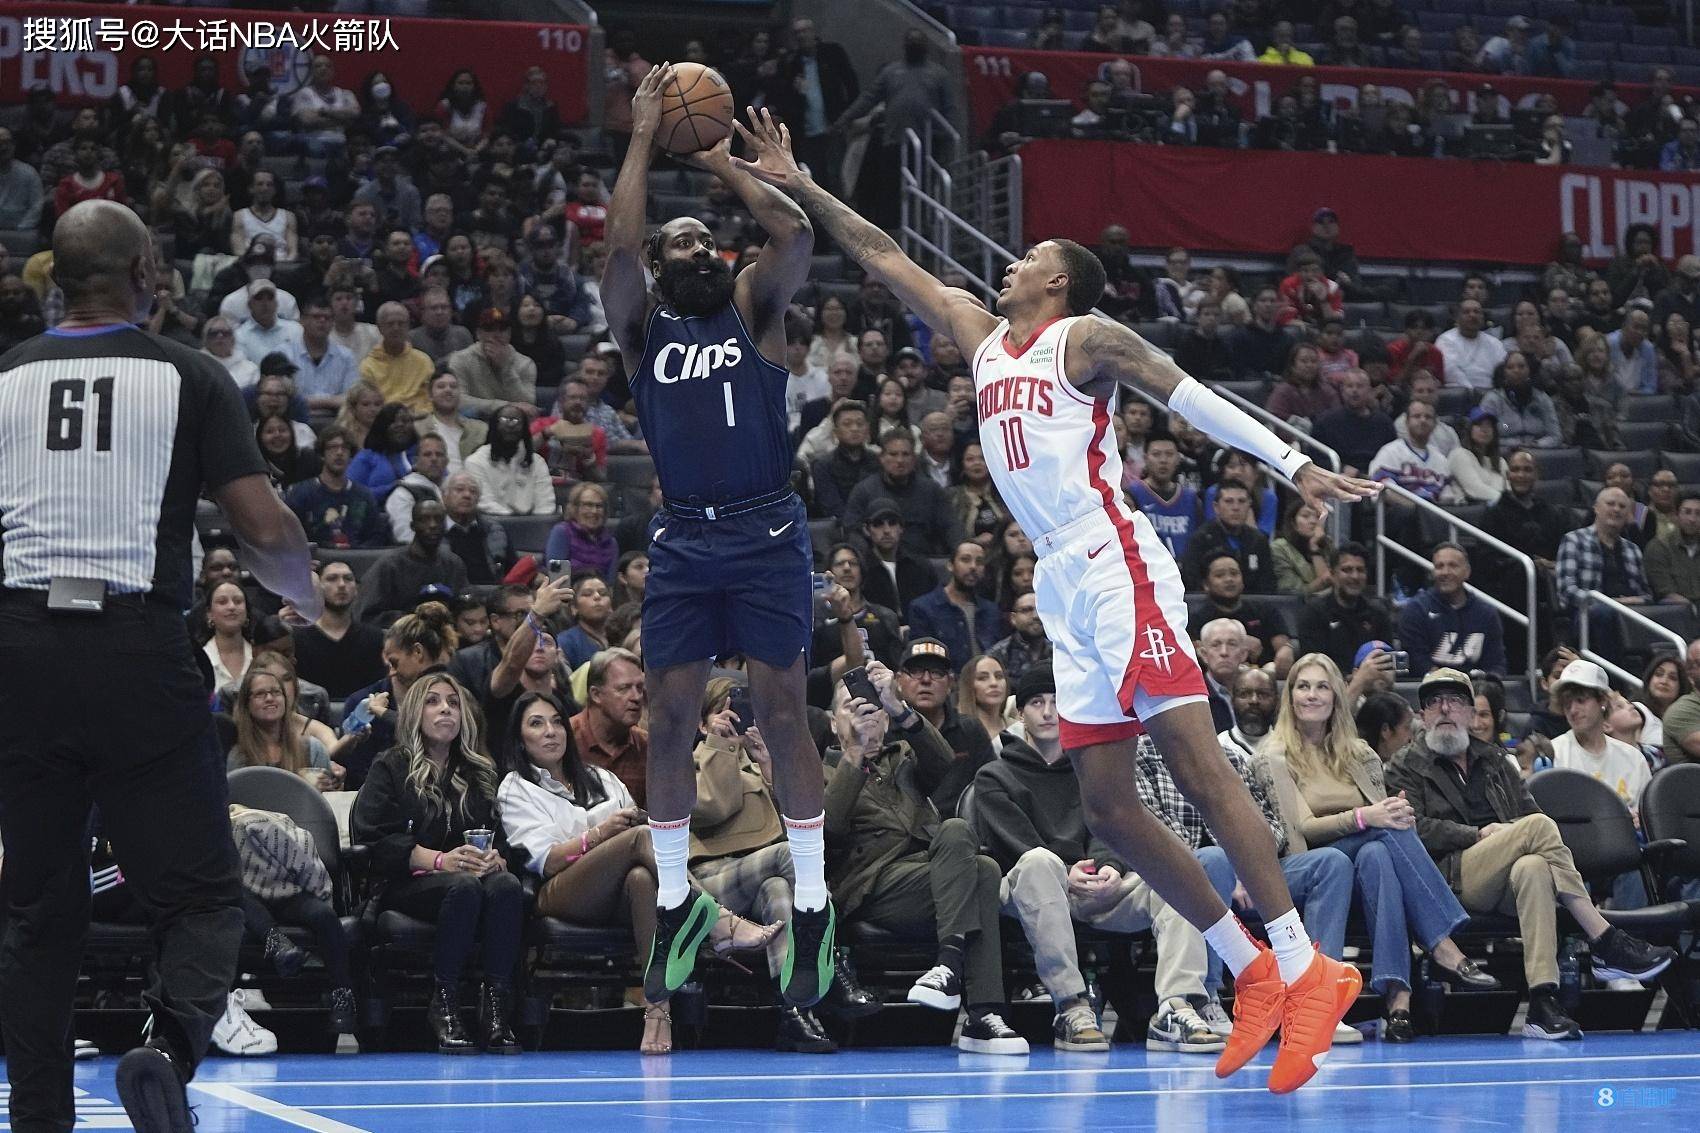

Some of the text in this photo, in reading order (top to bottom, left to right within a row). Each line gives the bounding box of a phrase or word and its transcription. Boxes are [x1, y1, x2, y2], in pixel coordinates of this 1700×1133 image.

[538, 28, 581, 53] 110
[974, 54, 1013, 77] 111
[1561, 172, 1700, 258] CLIPP
[1029, 356, 1053, 365] karma
[1032, 346, 1054, 357] credit
[46, 376, 115, 452] 61
[723, 381, 735, 427] 1
[978, 376, 1053, 426] ROCKETS
[1000, 416, 1030, 471] 10
